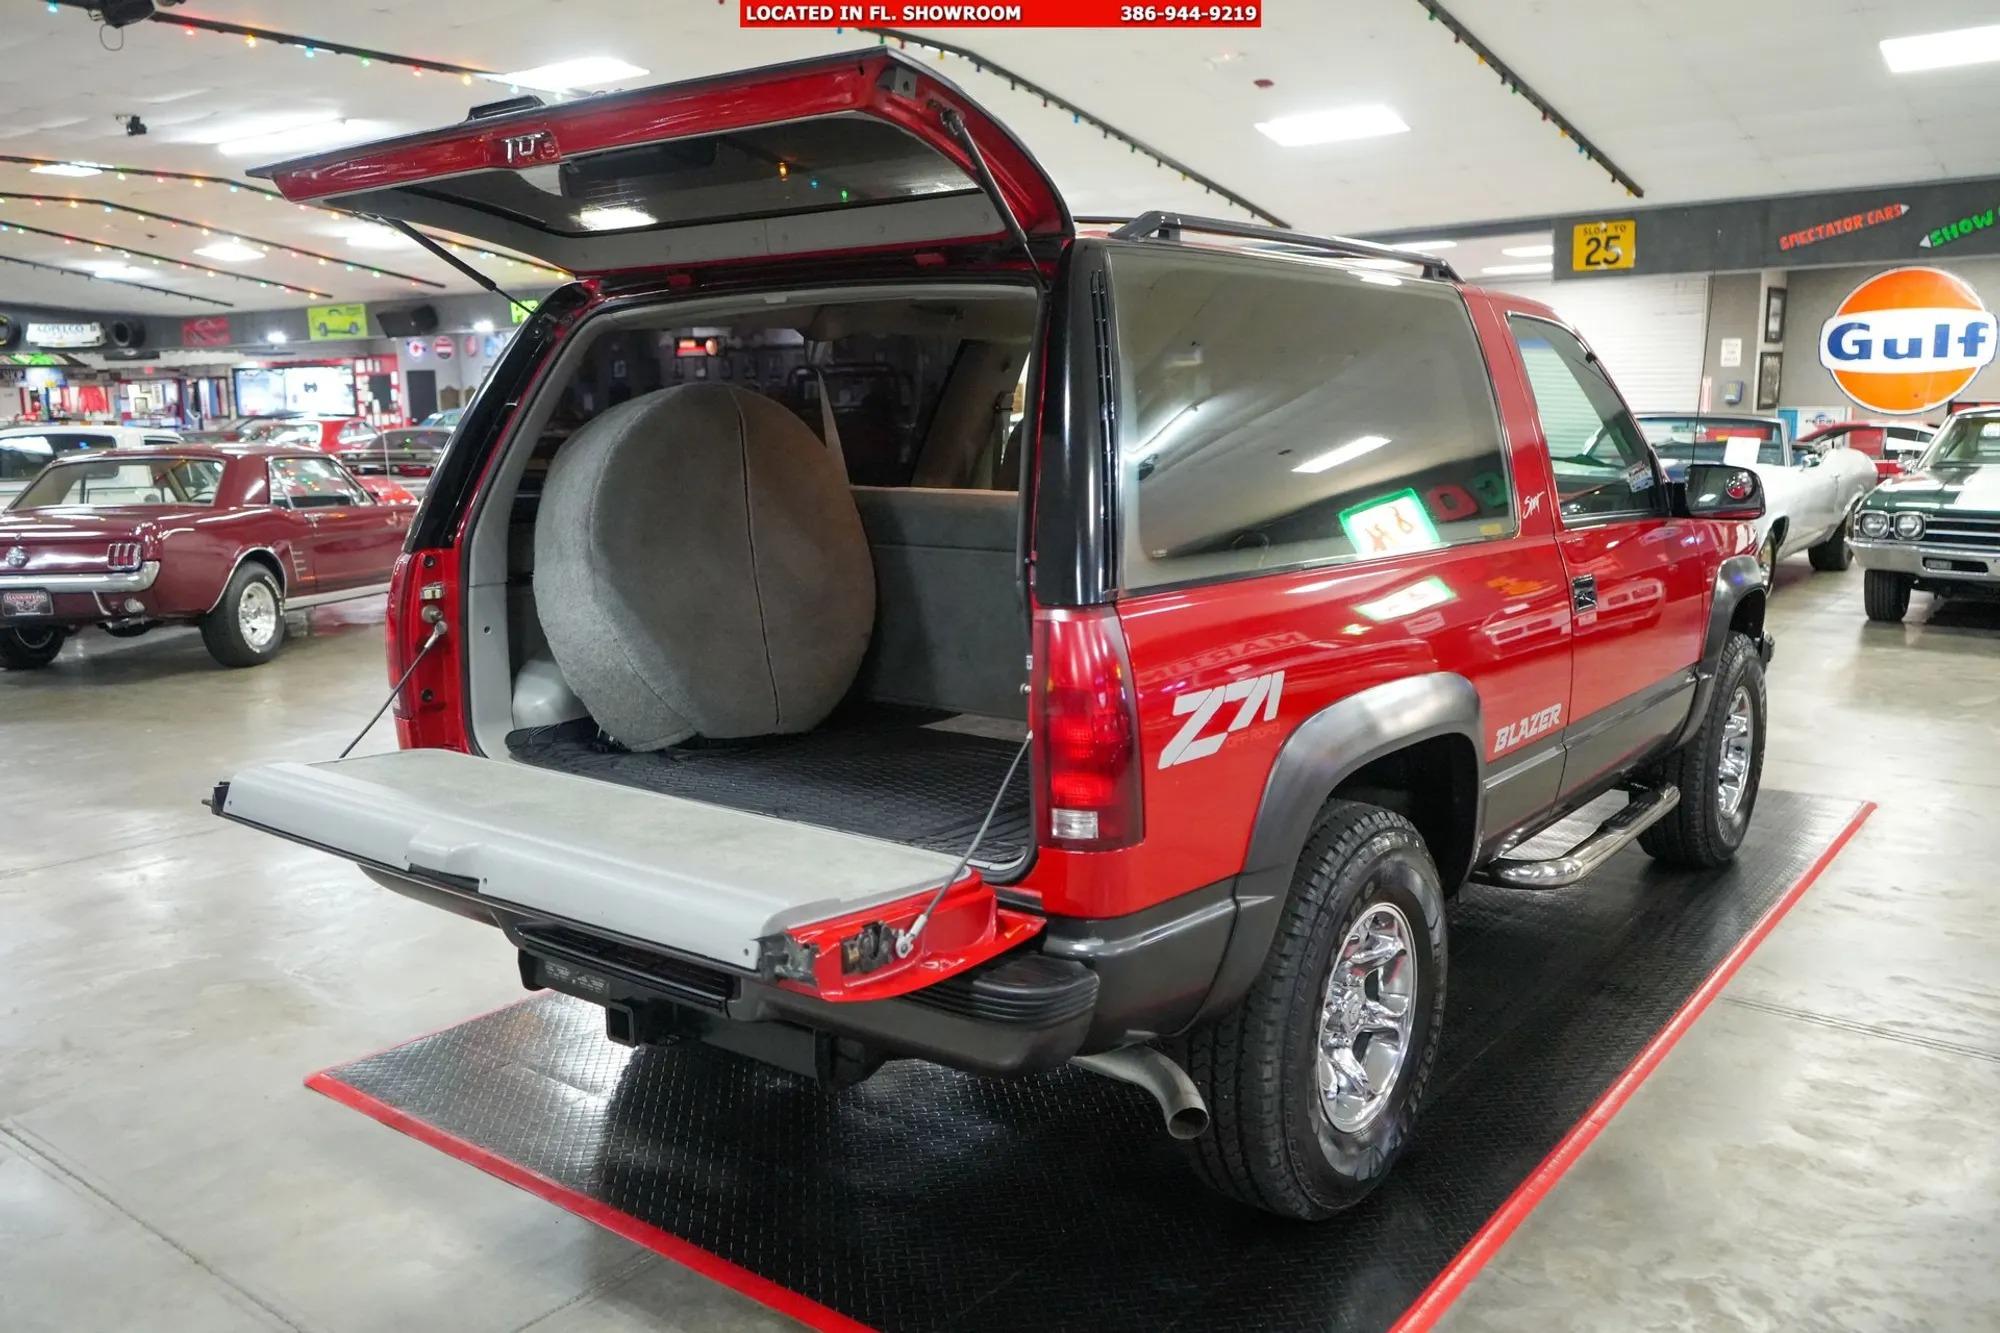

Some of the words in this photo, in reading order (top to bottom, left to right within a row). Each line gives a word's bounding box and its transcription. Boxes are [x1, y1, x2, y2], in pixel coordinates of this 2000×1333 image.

[1779, 214, 1864, 250] SPECTATOR
[1866, 203, 1902, 225] CARS
[1929, 208, 1994, 247] SHOW
[1585, 235, 1622, 266] 25
[1827, 321, 1990, 362] Gulf
[1157, 669, 1285, 770] Z71
[1493, 703, 1562, 754] BLAZER
